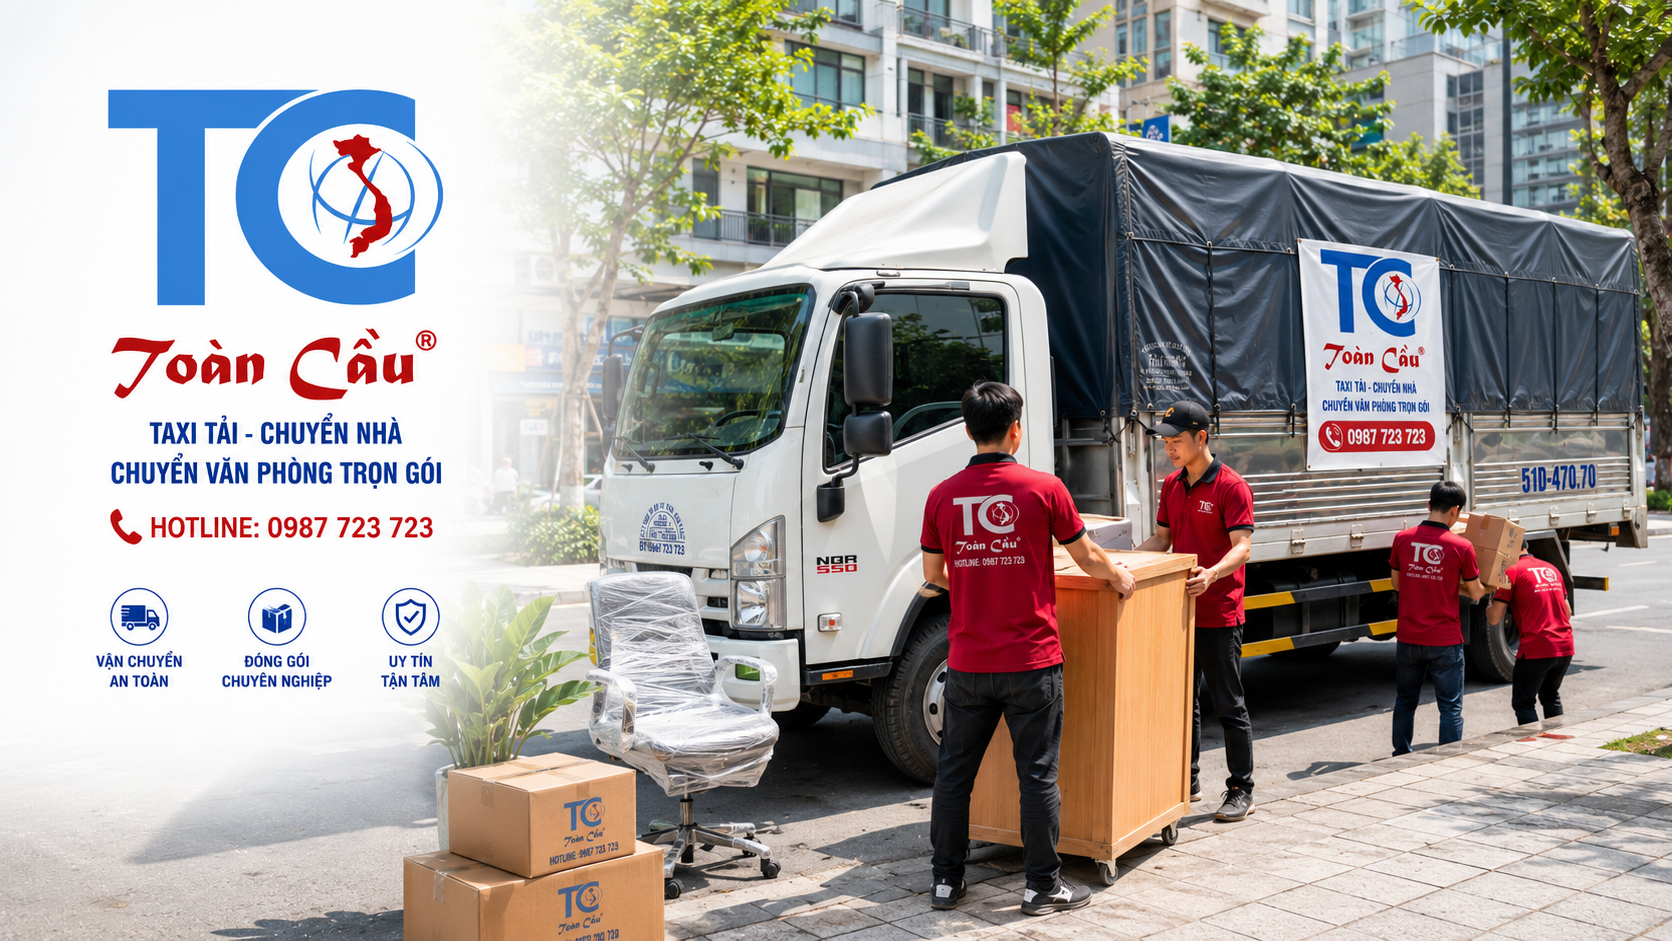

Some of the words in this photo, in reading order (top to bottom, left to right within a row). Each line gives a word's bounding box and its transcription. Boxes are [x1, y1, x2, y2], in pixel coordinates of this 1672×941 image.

[1323, 343, 1375, 370] Toàn
[1335, 380, 1353, 392] TAXI
[1348, 428, 1377, 445] 0987
[1381, 428, 1402, 445] 723
[1405, 428, 1426, 445] 723
[1521, 464, 1597, 493] 51D-470.70
